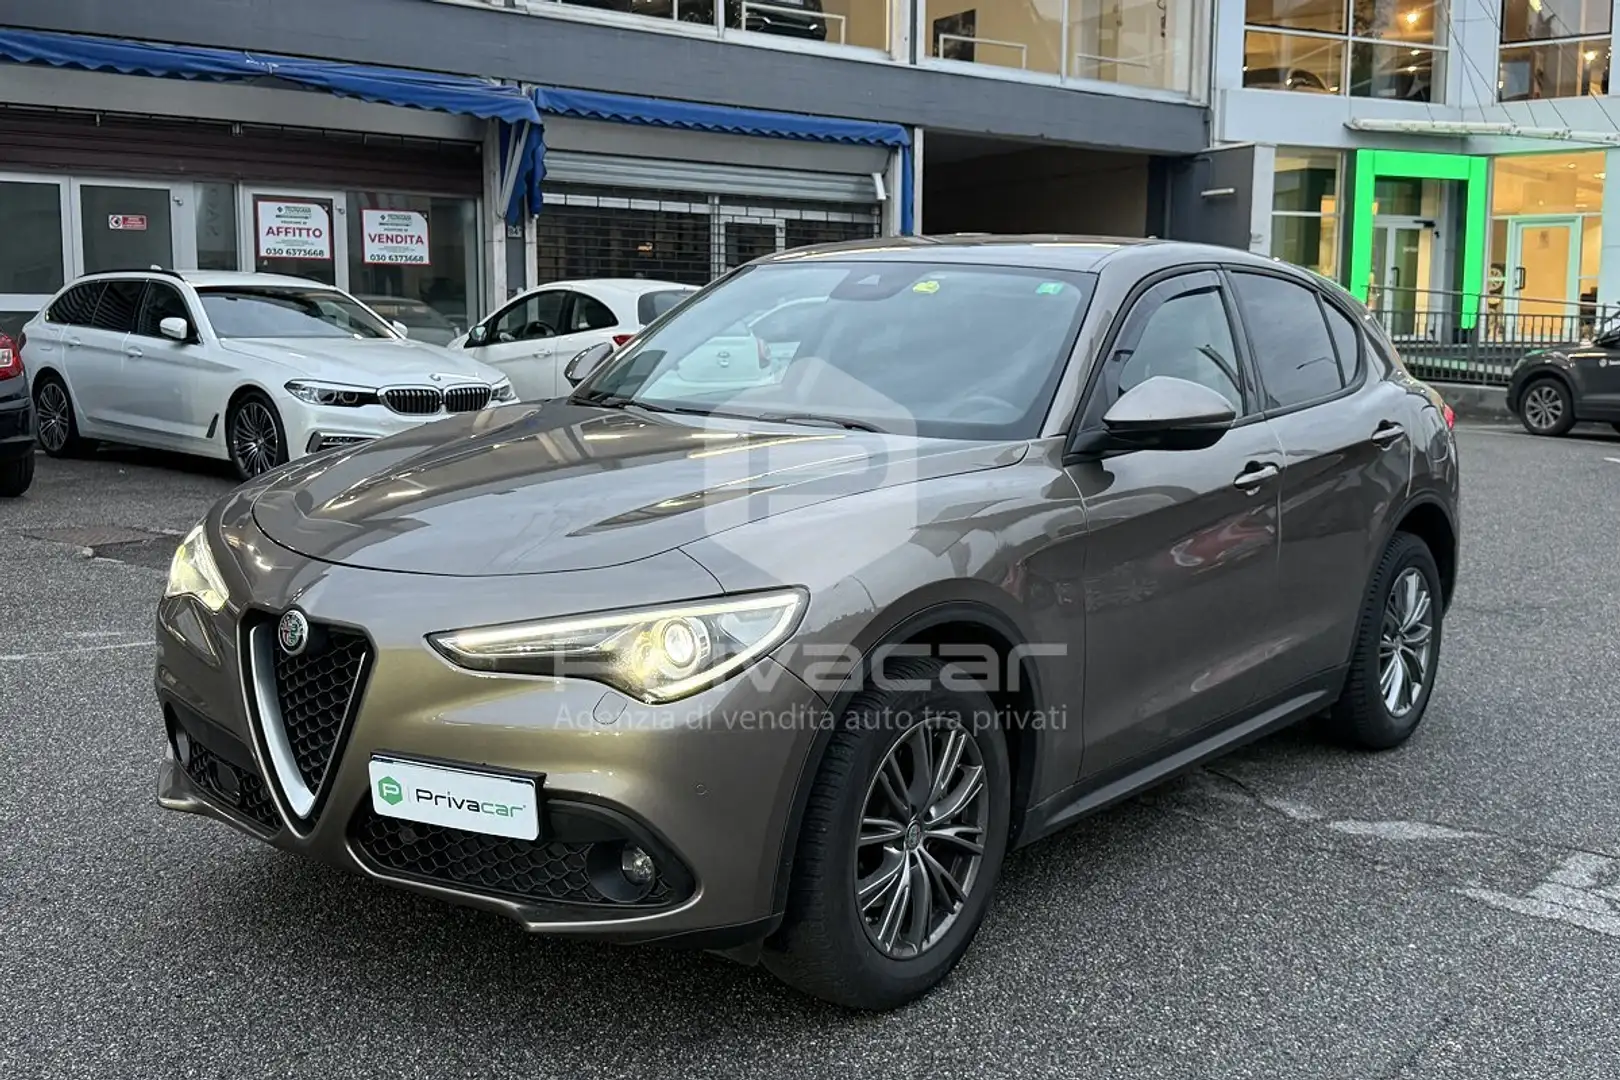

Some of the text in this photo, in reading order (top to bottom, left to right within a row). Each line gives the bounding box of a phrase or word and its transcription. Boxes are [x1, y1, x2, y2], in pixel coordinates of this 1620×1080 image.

[266, 226, 323, 239] AFFITTO
[368, 233, 424, 245] VENDITA
[265, 247, 325, 258] 030 6373668
[369, 253, 424, 263] 030 6373668
[415, 788, 523, 818] Privacar
